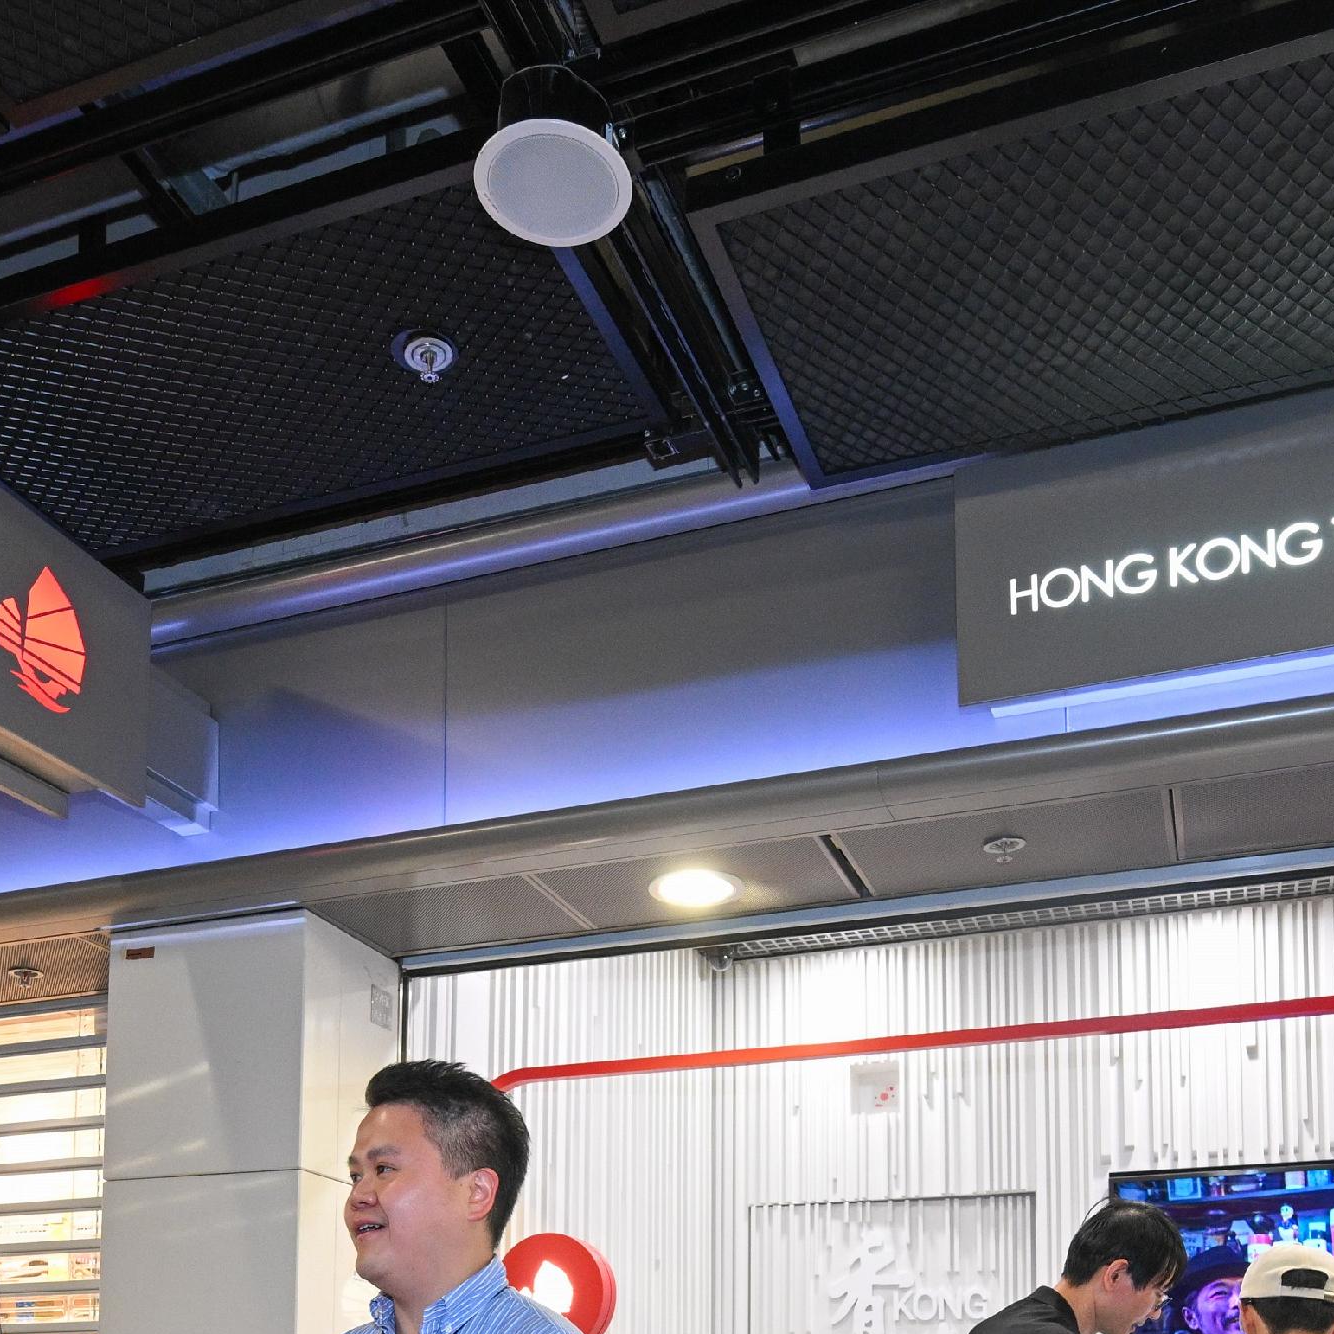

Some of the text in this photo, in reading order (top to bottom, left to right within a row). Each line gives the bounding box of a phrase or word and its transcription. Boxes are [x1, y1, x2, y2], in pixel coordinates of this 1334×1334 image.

[1009, 551, 1158, 616] HONG
[1165, 520, 1325, 588] KONG
[894, 1288, 989, 1322] KONG
